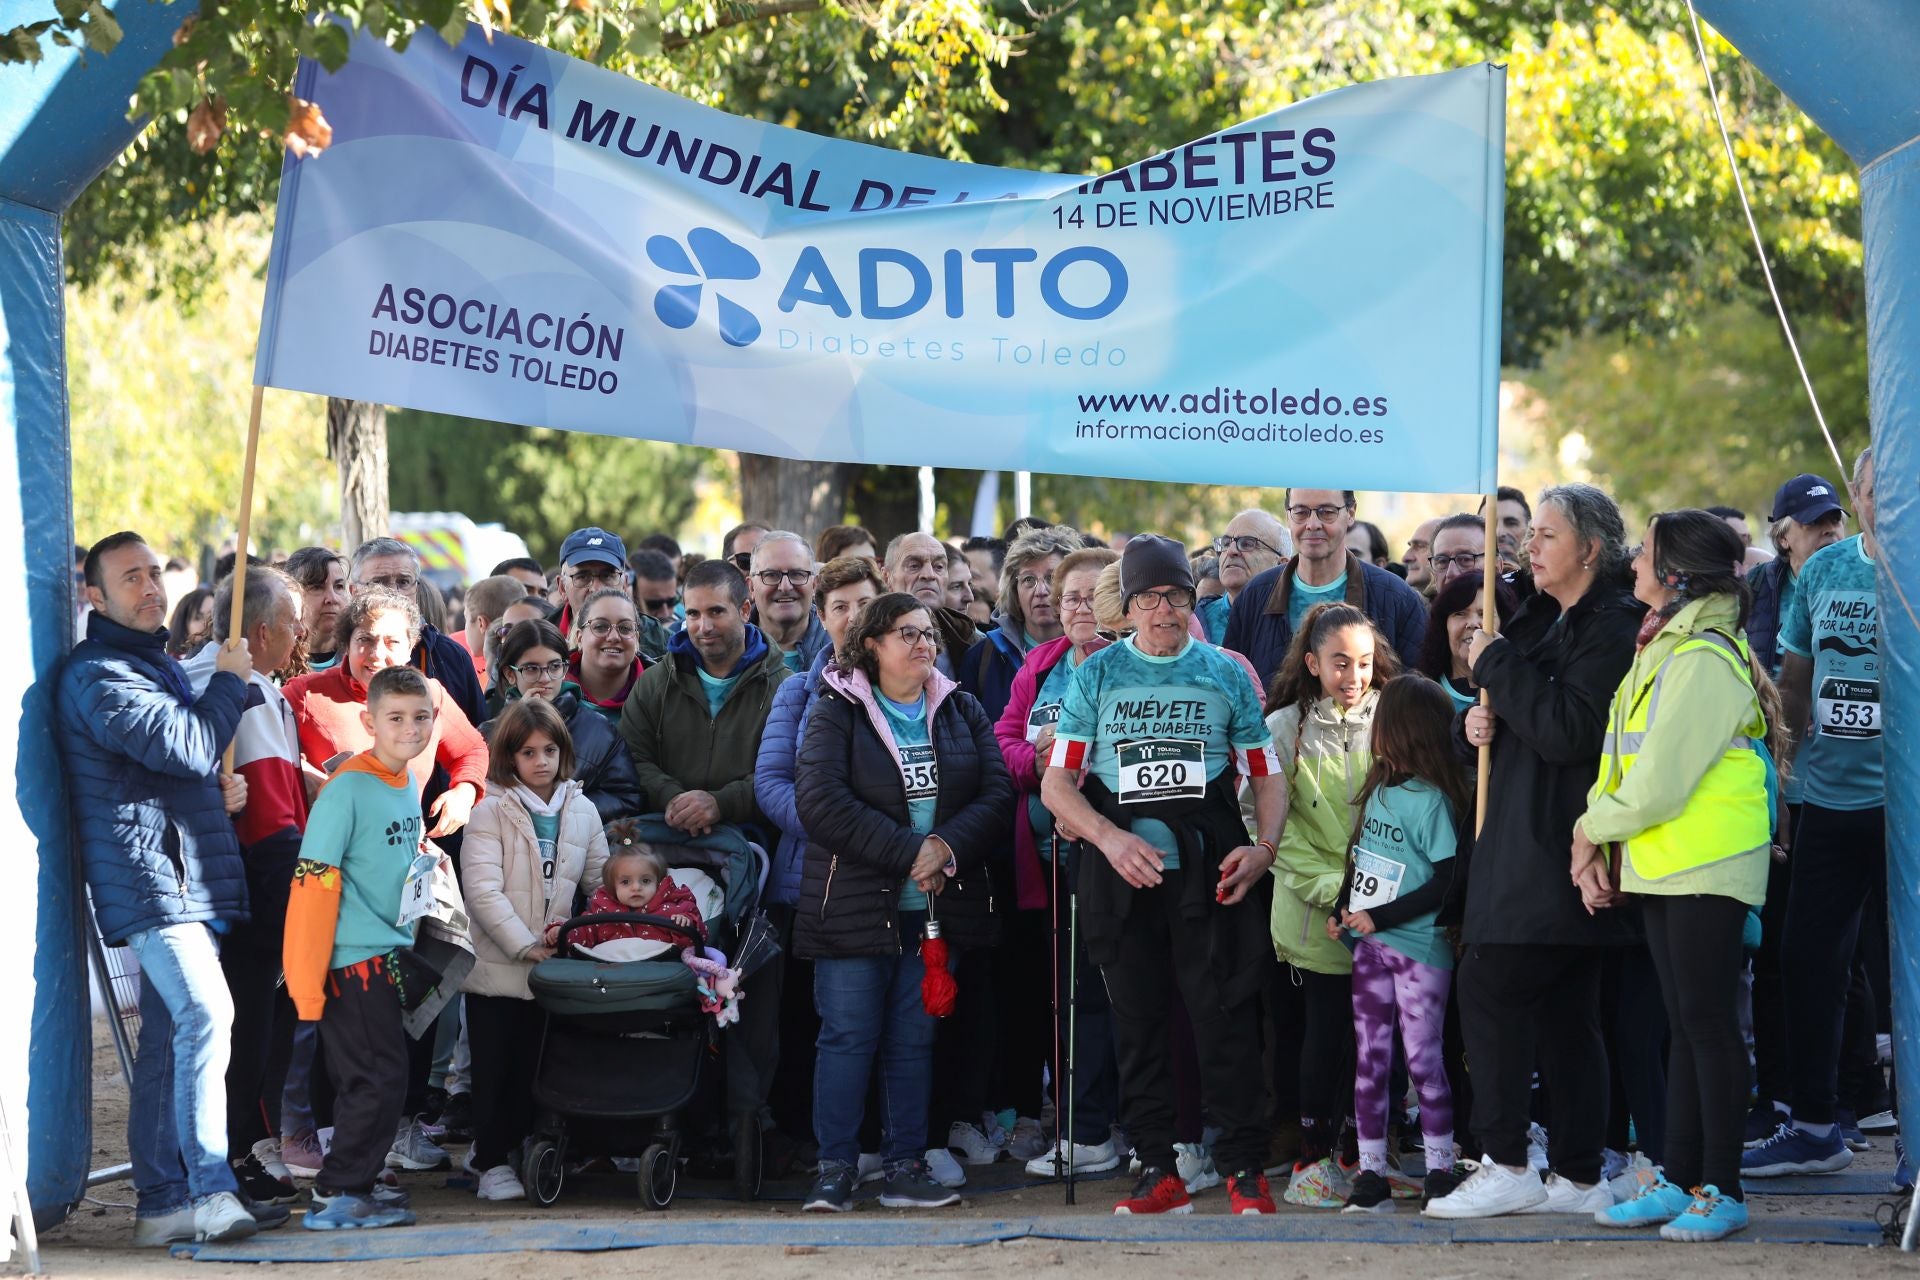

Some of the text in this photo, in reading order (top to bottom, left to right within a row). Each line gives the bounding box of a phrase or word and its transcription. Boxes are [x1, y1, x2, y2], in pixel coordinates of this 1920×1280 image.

[460, 54, 548, 130] DÍA
[565, 99, 830, 213] MUNDIAL
[1078, 127, 1336, 195] ABETES
[1053, 181, 1335, 230] 14 DE NOVIEMBRE
[777, 245, 1129, 321] ADITO
[371, 283, 624, 362] ASOCIACIÓN
[778, 328, 1126, 367] Diabetes Toledo
[369, 329, 618, 395] DIABETES TOLEDO
[1077, 386, 1388, 417] www.aditoledo.es
[1076, 419, 1384, 444] informacion@aditoledo.es
[1827, 596, 1876, 621] MUÉV
[1819, 619, 1877, 636] POR LA DIA
[1113, 694, 1207, 722] MUÉVETE
[1830, 702, 1874, 727] 553
[1105, 721, 1212, 736] POR LA DIABETES
[1136, 762, 1187, 788] 620
[402, 816, 421, 835] ADIT
[1364, 817, 1404, 843] ADITO
